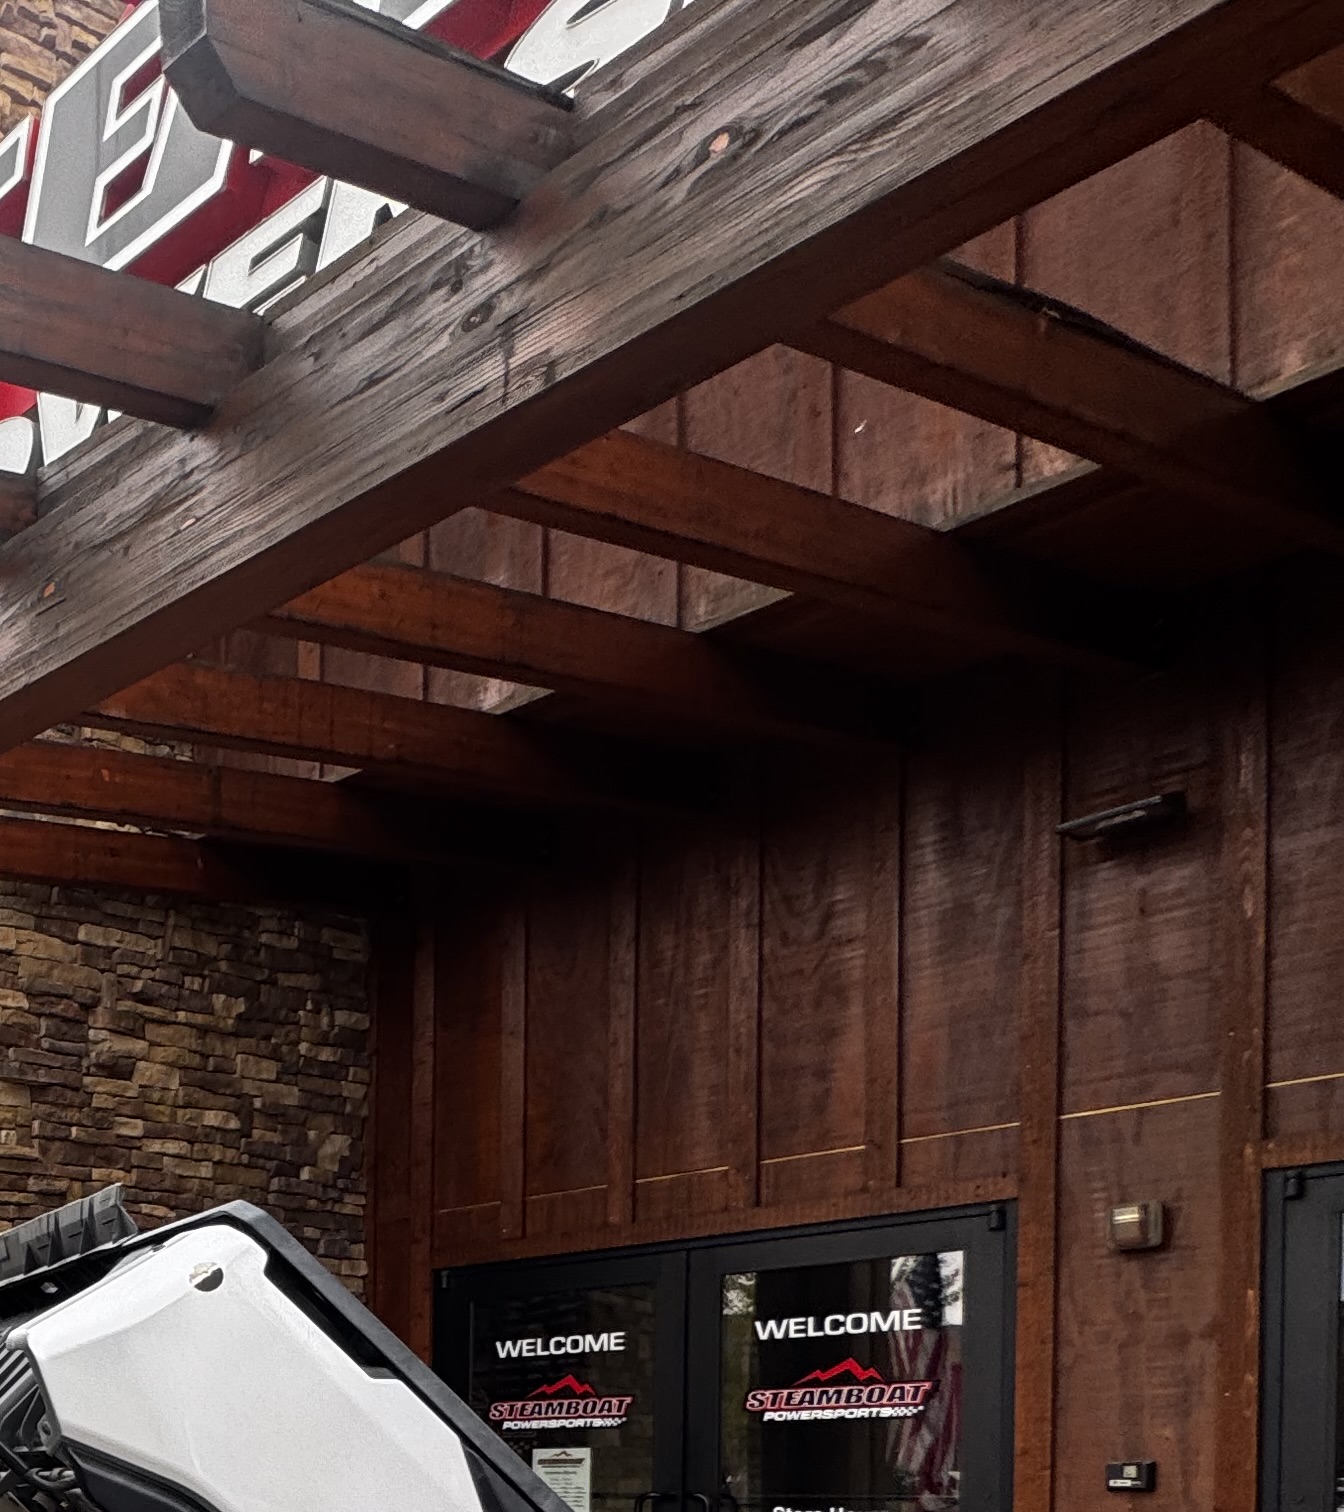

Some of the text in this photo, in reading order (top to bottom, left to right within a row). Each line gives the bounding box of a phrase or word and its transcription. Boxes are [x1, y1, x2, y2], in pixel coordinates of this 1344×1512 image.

[755, 1309, 923, 1341] WELCOME
[496, 1332, 626, 1359] WELCOME
[489, 1396, 633, 1420] STEAMBOAT
[745, 1381, 933, 1410] STEAMBOAT
[502, 1417, 605, 1430] POWERSPORTS
[763, 1407, 890, 1422] POWERSPORTS
